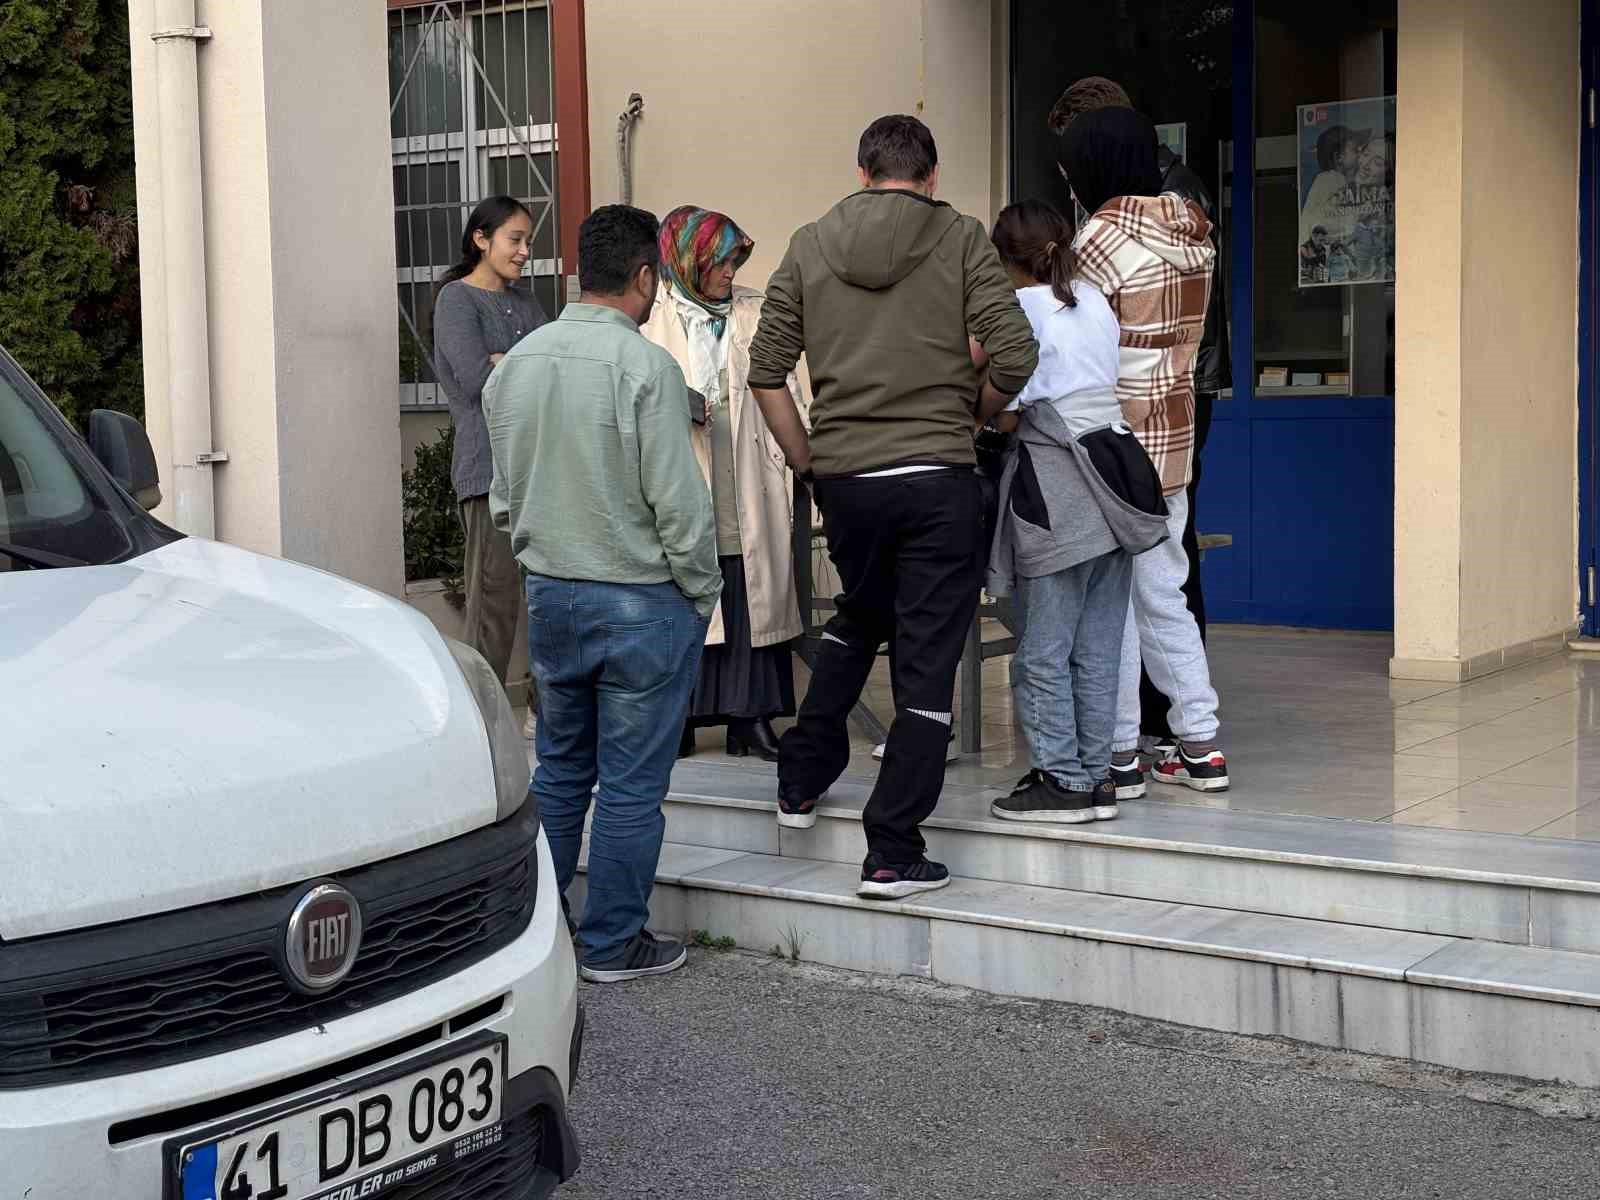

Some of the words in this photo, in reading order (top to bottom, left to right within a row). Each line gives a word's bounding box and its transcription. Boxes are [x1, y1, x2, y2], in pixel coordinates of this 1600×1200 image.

[308, 912, 349, 962] FIAT
[220, 1130, 288, 1200] 41
[319, 1093, 392, 1183] DB
[408, 1057, 493, 1143] 083
